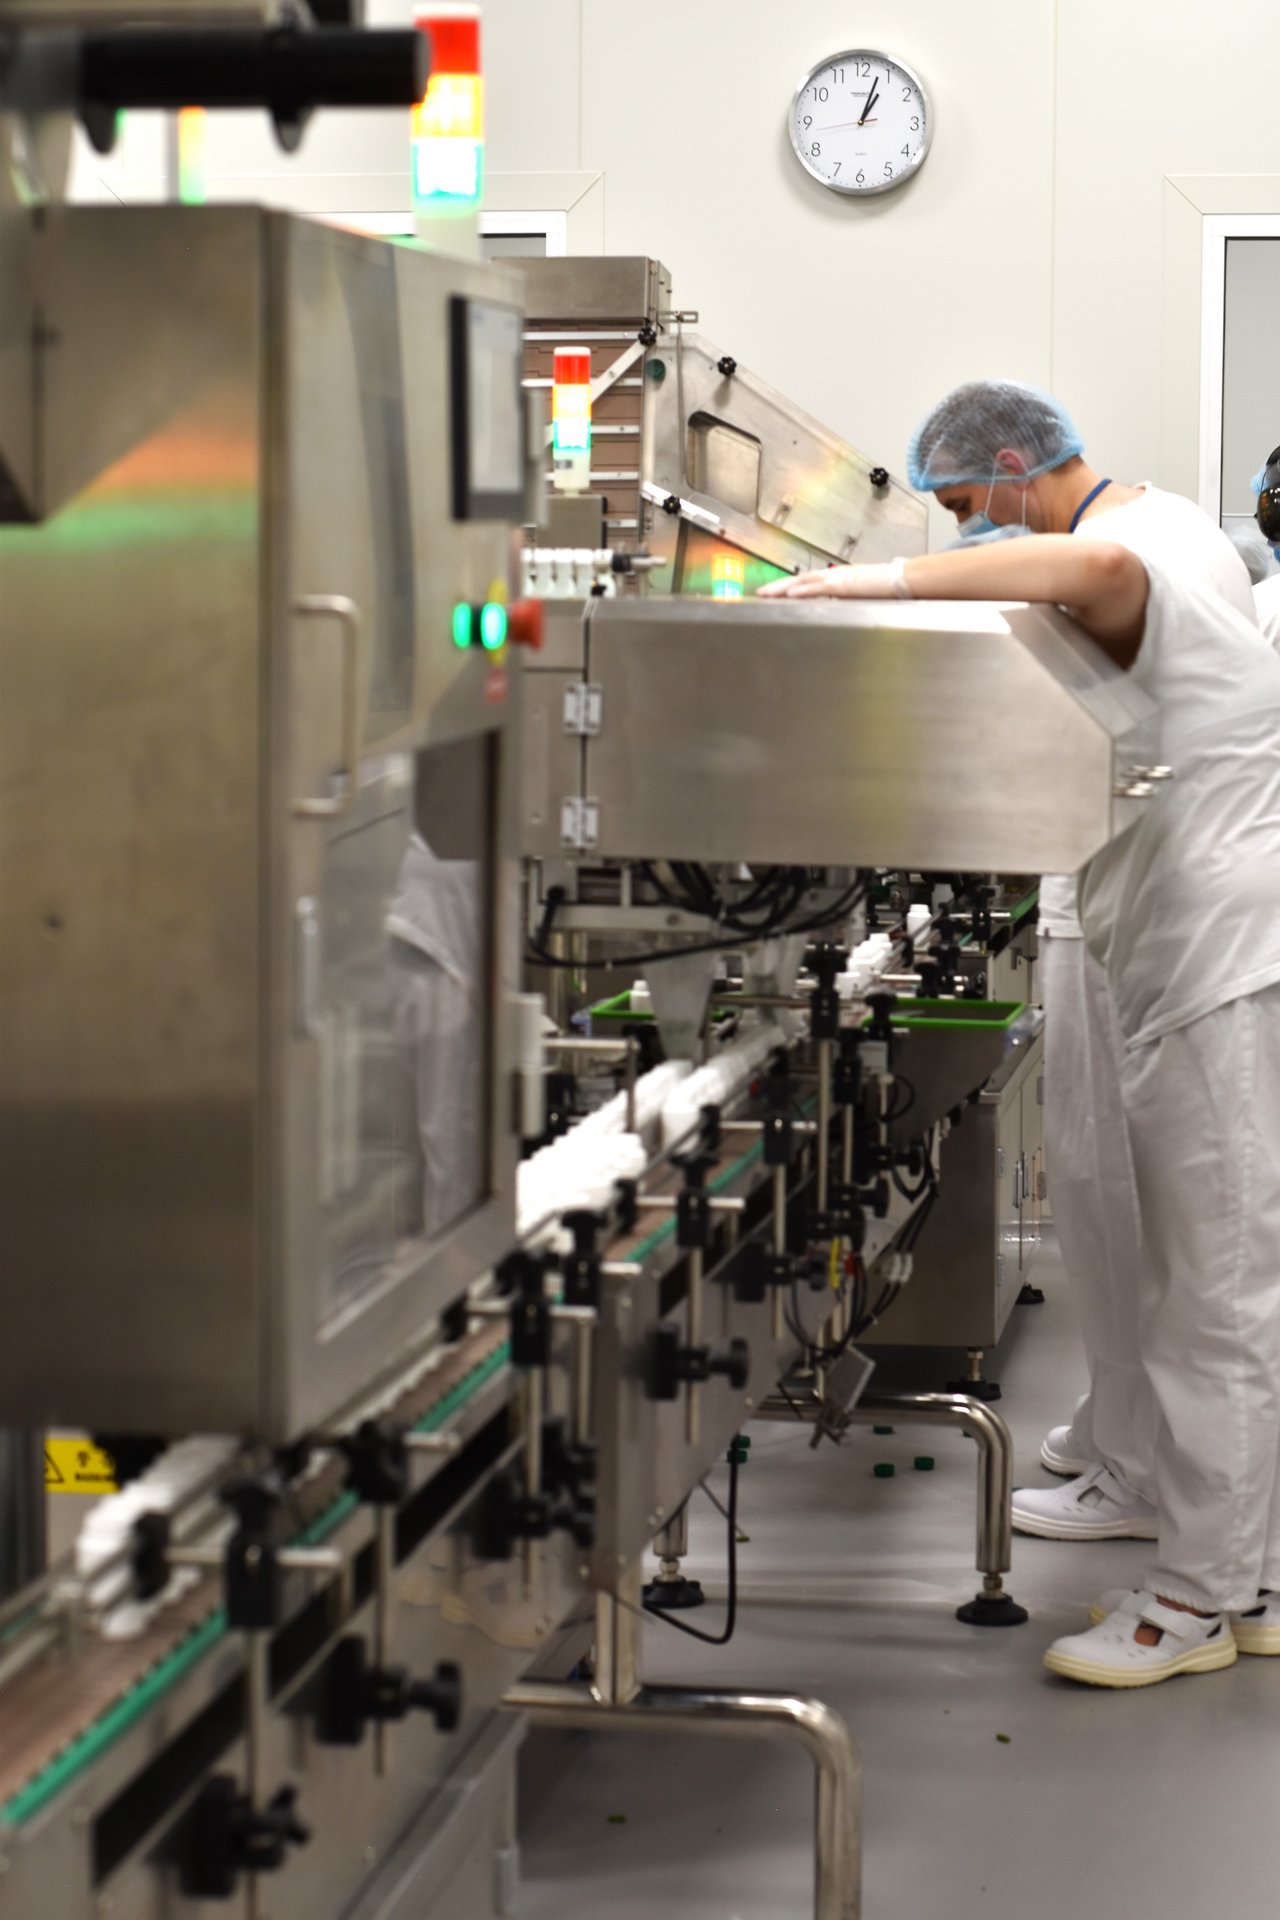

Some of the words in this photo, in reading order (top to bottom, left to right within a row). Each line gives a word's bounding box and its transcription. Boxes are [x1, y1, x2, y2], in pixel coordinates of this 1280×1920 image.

[832, 68, 845, 84] 11
[854, 62, 871, 78] 12
[886, 68, 891, 84] 1
[812, 87, 829, 102] 10
[902, 87, 912, 102] 2
[803, 115, 813, 131] 9
[909, 116, 920, 131] 3
[810, 142, 821, 157] 8
[900, 143, 910, 158] 4
[833, 162, 842, 177] 7
[855, 168, 865, 183] 6
[883, 161, 893, 177] 5
